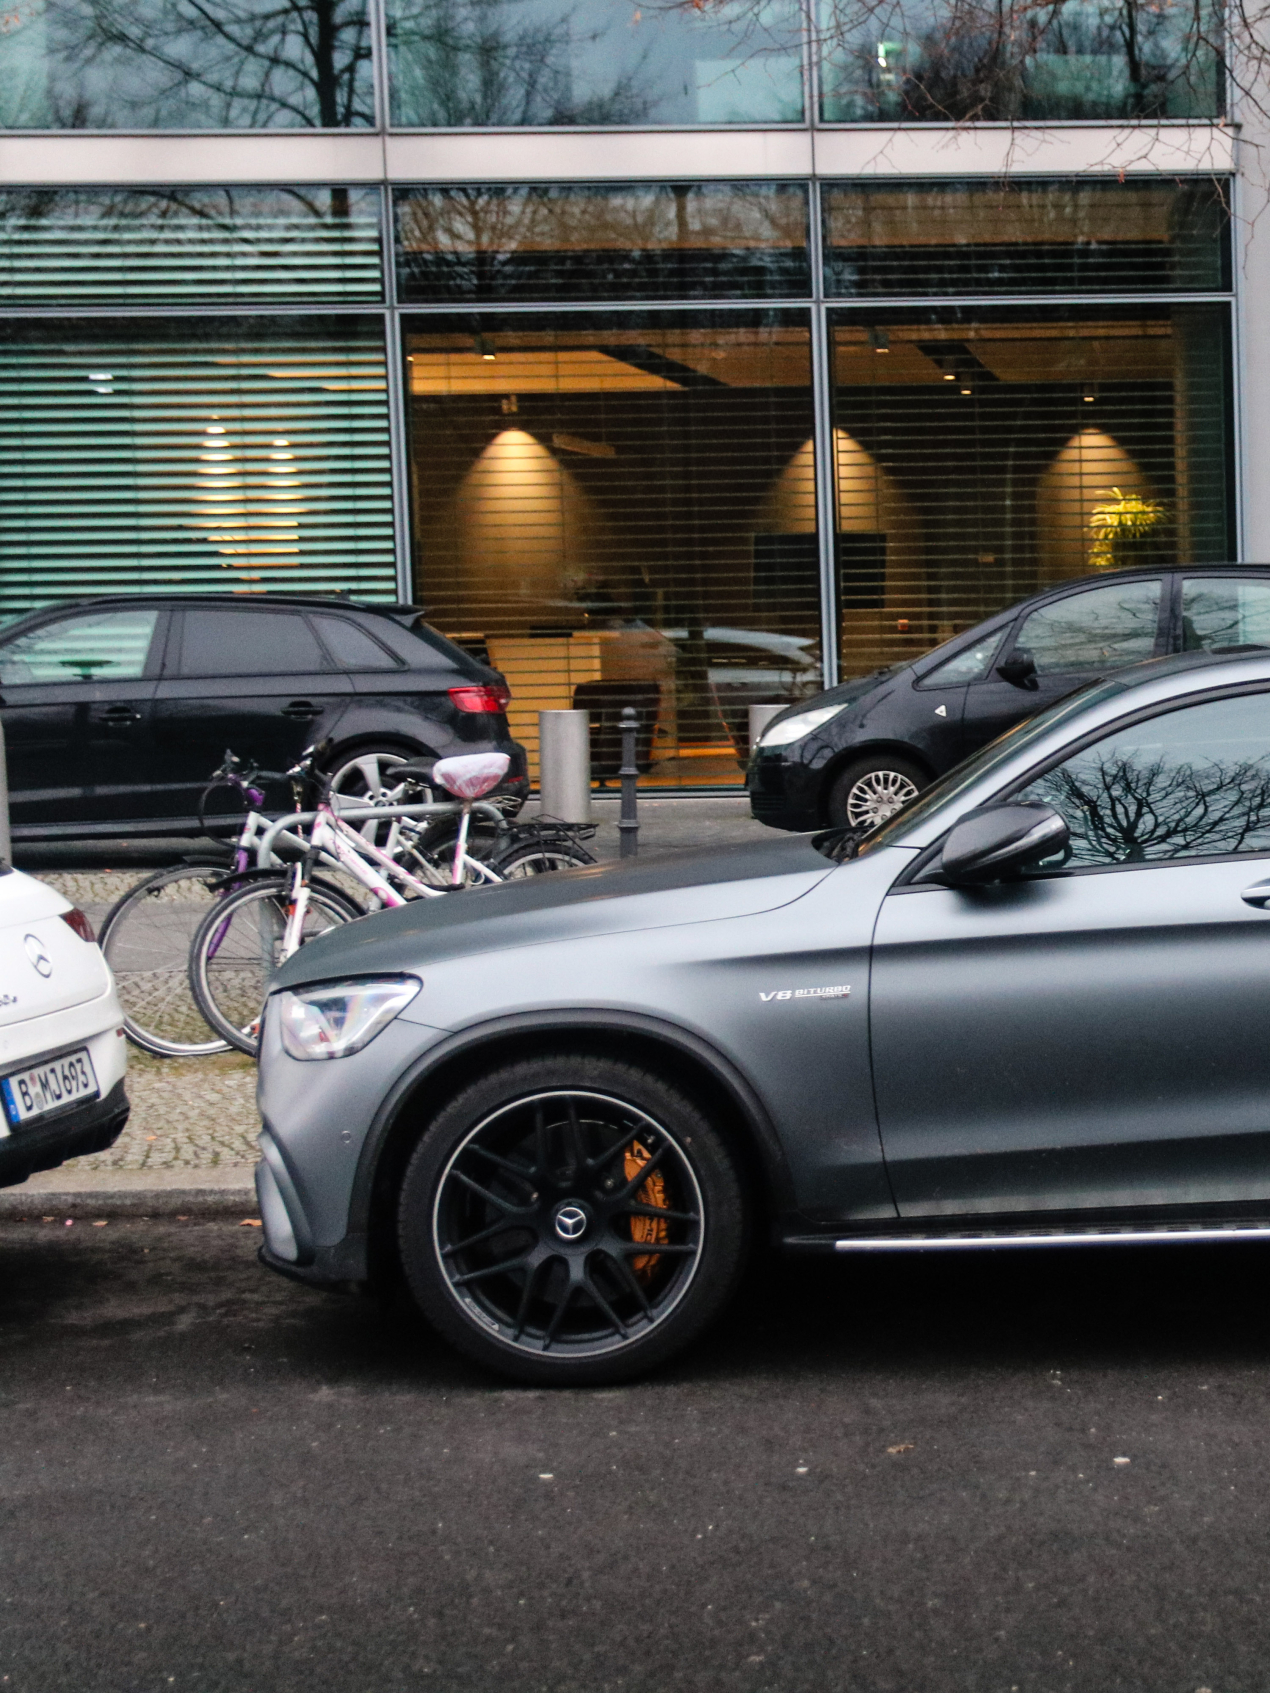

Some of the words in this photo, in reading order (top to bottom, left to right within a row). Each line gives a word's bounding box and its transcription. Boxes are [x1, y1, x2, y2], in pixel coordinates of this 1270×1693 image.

[758, 990, 793, 1002] V8
[795, 984, 851, 996] BITURBO
[17, 1078, 34, 1112] B
